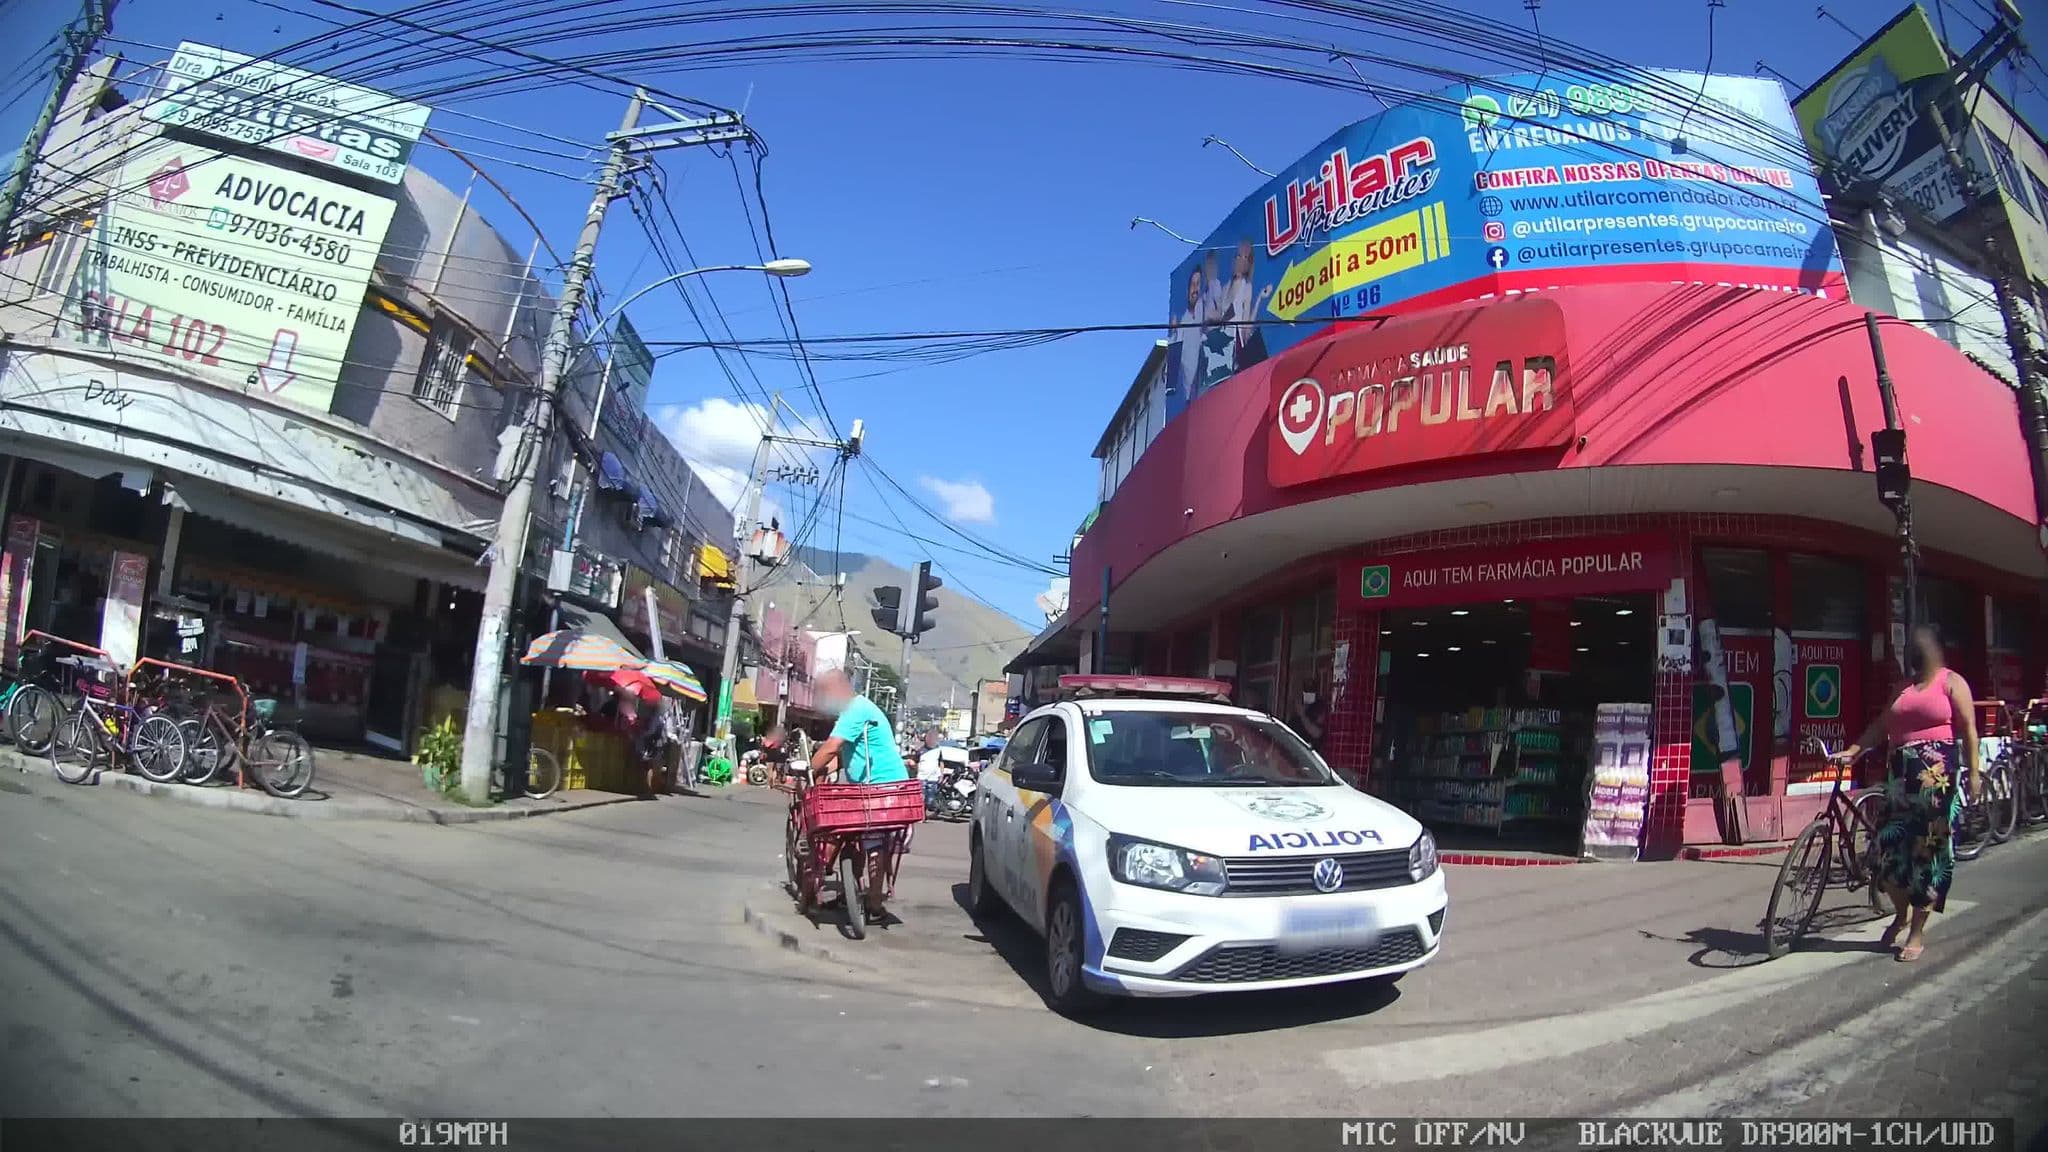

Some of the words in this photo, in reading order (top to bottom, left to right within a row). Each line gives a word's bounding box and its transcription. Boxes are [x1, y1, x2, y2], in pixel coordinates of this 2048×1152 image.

[173, 55, 206, 77] Dra.
[178, 109, 189, 122] 9
[342, 154, 372, 174] Sala
[374, 162, 399, 179] 103
[1475, 167, 1561, 191] CONFIRA
[1562, 161, 1642, 184] NOSSAS
[1645, 159, 1729, 186] OFERTAS
[1729, 164, 1793, 188] ONLINE
[215, 172, 367, 236] ADVOCACIA
[1266, 138, 1435, 254] Utilar
[1301, 167, 1441, 247] Presentes
[229, 213, 351, 265] 97036-4580
[1512, 212, 1808, 238] @utilarpresentes.grupocarneiro
[113, 225, 159, 252] INSS
[173, 240, 338, 302] PREVIDENCIÁRIO
[1517, 238, 1815, 263] @utilarpresentes.grupocarneiro
[1278, 274, 1316, 311] Logo
[1319, 253, 1341, 287] ali
[1347, 253, 1360, 273] a
[1366, 231, 1417, 266] 50m
[87, 249, 169, 285] TRABALHISTA
[181, 274, 273, 313] CONSUMIDOR
[285, 303, 347, 335] FAMÍLIA
[1357, 284, 1382, 310] 96
[161, 313, 229, 368] 102
[1325, 355, 1556, 447] POPULAR
[1403, 569, 1437, 588] AQUI
[1442, 565, 1473, 585] TEM
[1477, 556, 1557, 582] FARMÁCIA
[1561, 551, 1643, 576] POPULAR
[1726, 650, 1760, 673] TEM
[1801, 645, 1823, 660] AQUI
[1824, 646, 1844, 660] TEM
